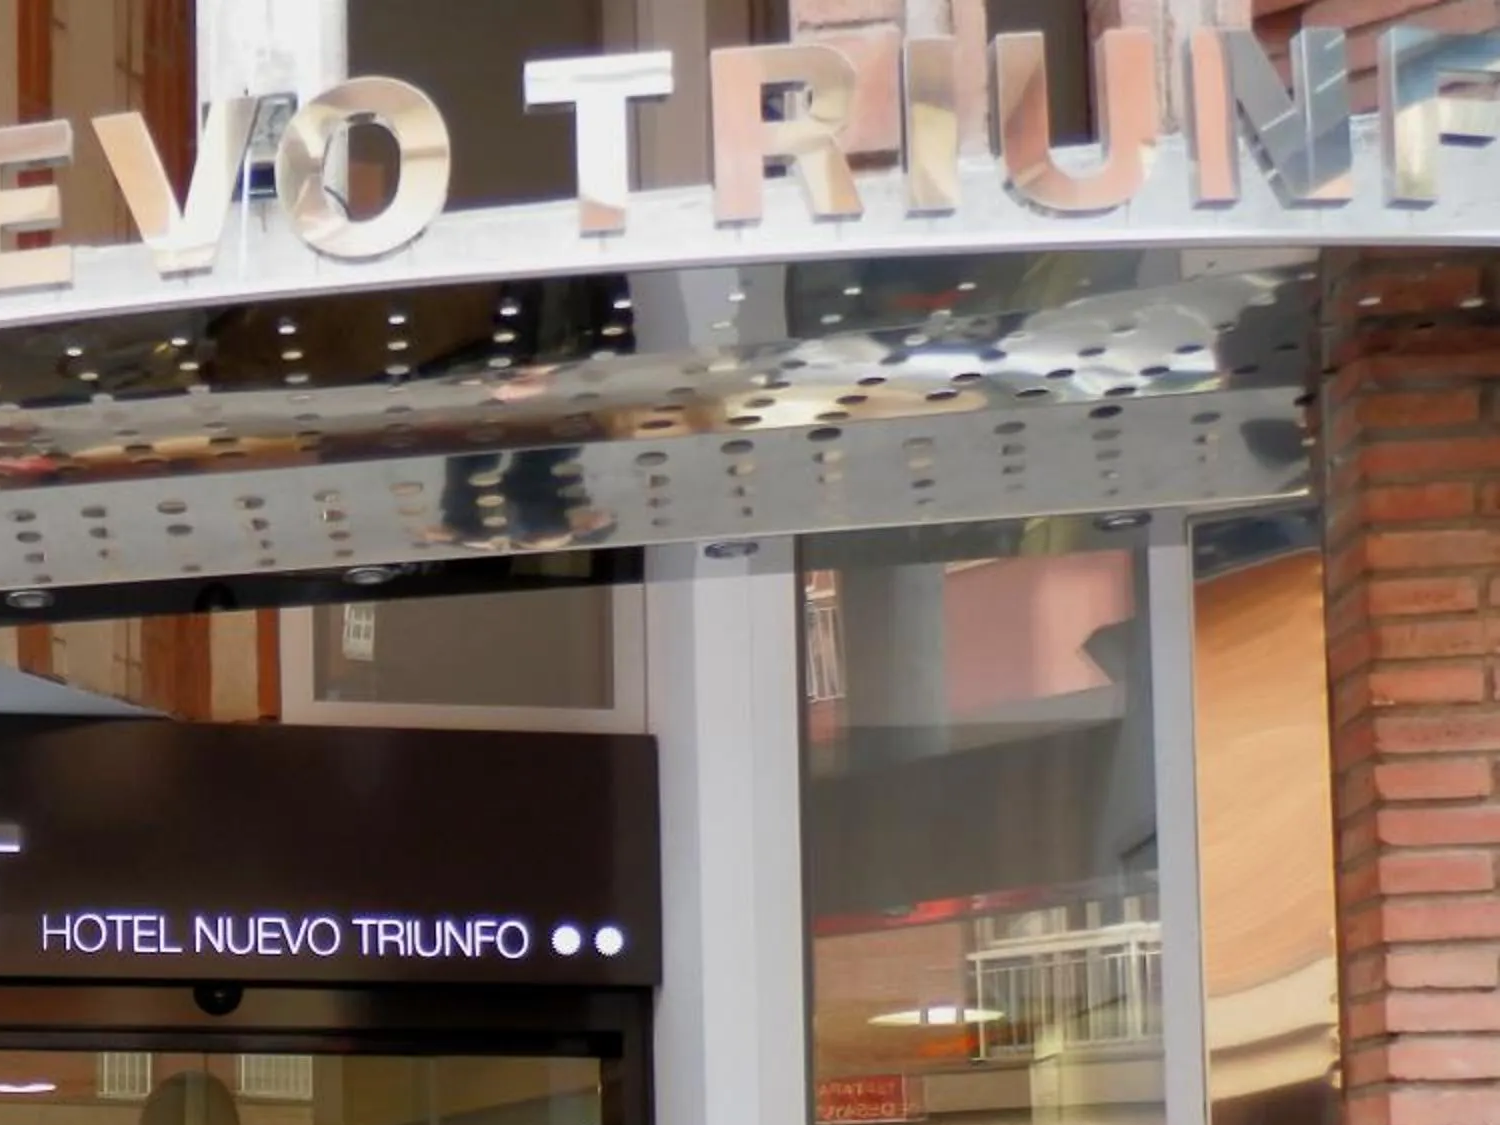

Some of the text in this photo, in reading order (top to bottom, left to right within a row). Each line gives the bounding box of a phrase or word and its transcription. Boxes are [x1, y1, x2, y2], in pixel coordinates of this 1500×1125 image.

[41, 912, 531, 960] HOTEL NUEVO TRIUNFO
